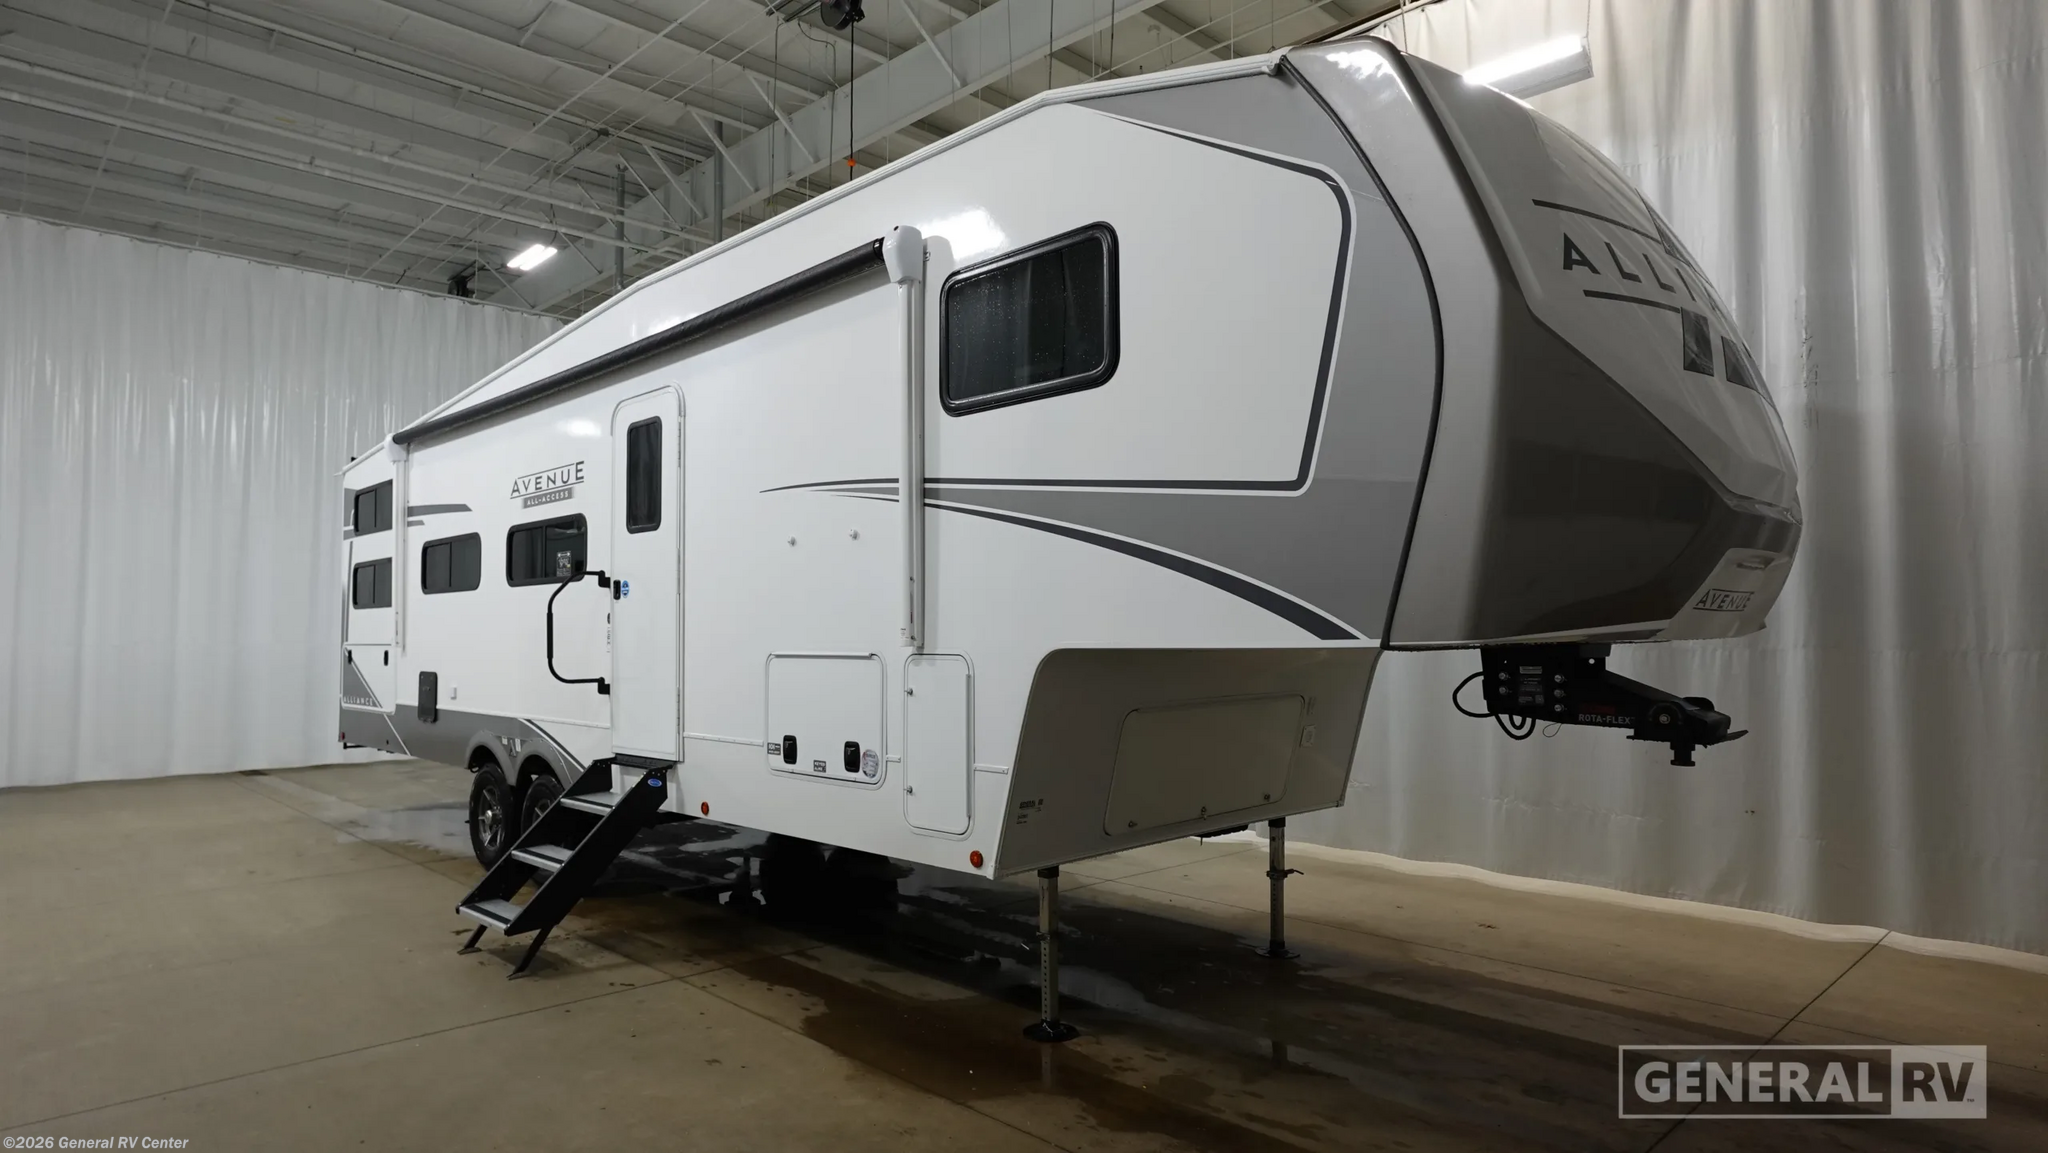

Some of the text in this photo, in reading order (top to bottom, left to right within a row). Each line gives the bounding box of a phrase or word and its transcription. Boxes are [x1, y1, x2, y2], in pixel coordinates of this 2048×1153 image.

[511, 460, 585, 497] AVENUE
[526, 490, 569, 506] ALL-ACCESS
[1695, 588, 1755, 610] AVENUE
[343, 695, 373, 706] ALLIANCE
[1578, 713, 1632, 725] ROTA-FLEX
